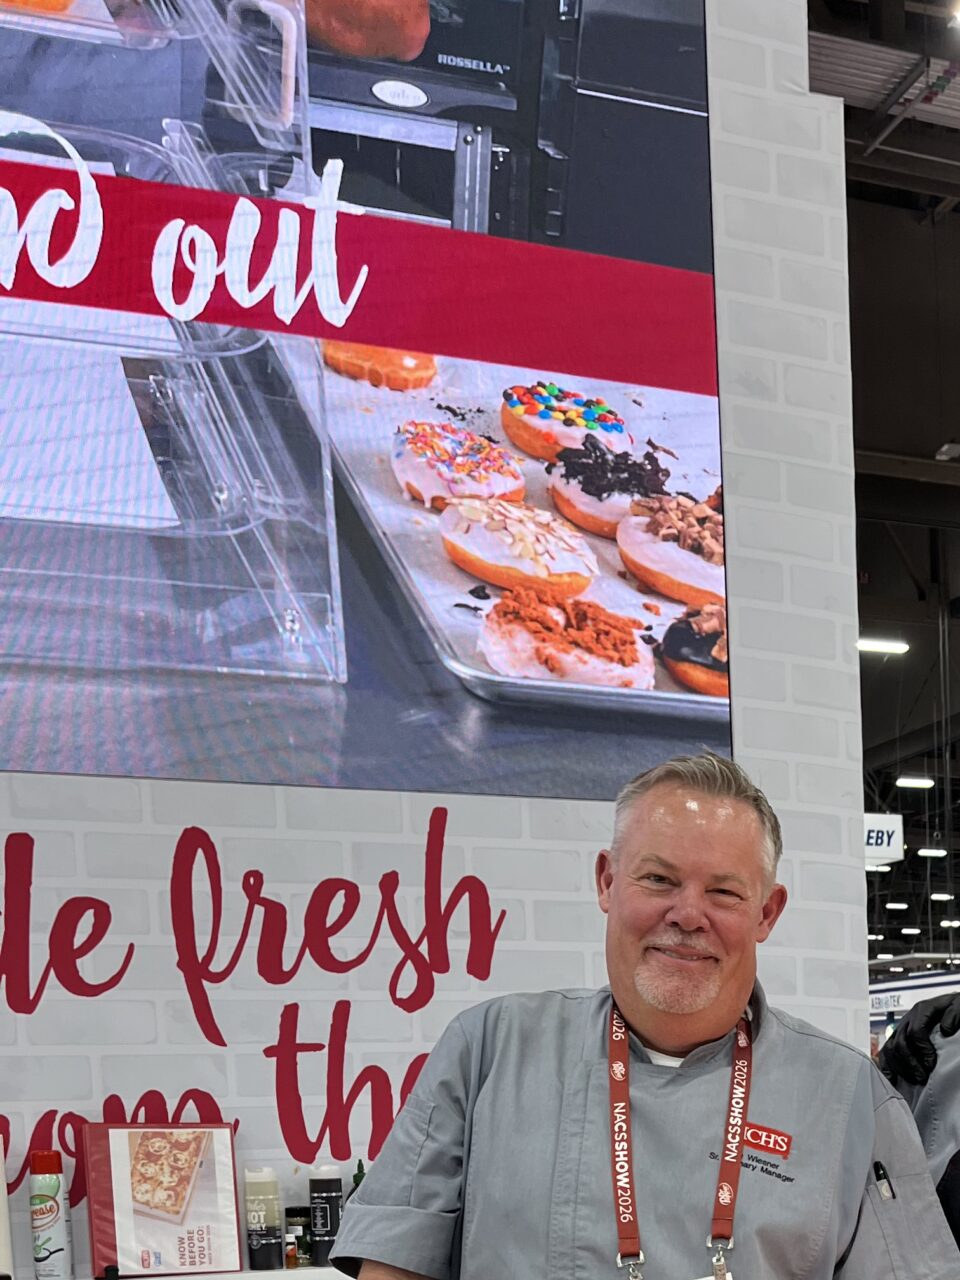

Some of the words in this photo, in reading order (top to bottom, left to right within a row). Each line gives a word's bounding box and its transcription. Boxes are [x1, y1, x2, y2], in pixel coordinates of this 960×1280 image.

[152, 158, 369, 328] out
[170, 806, 507, 1047] fresh
[263, 1000, 432, 1164] th
[760, 1165, 796, 1183] Manager
[187, 1229, 197, 1266] BEFORE
[198, 1246, 206, 1266] YOU
